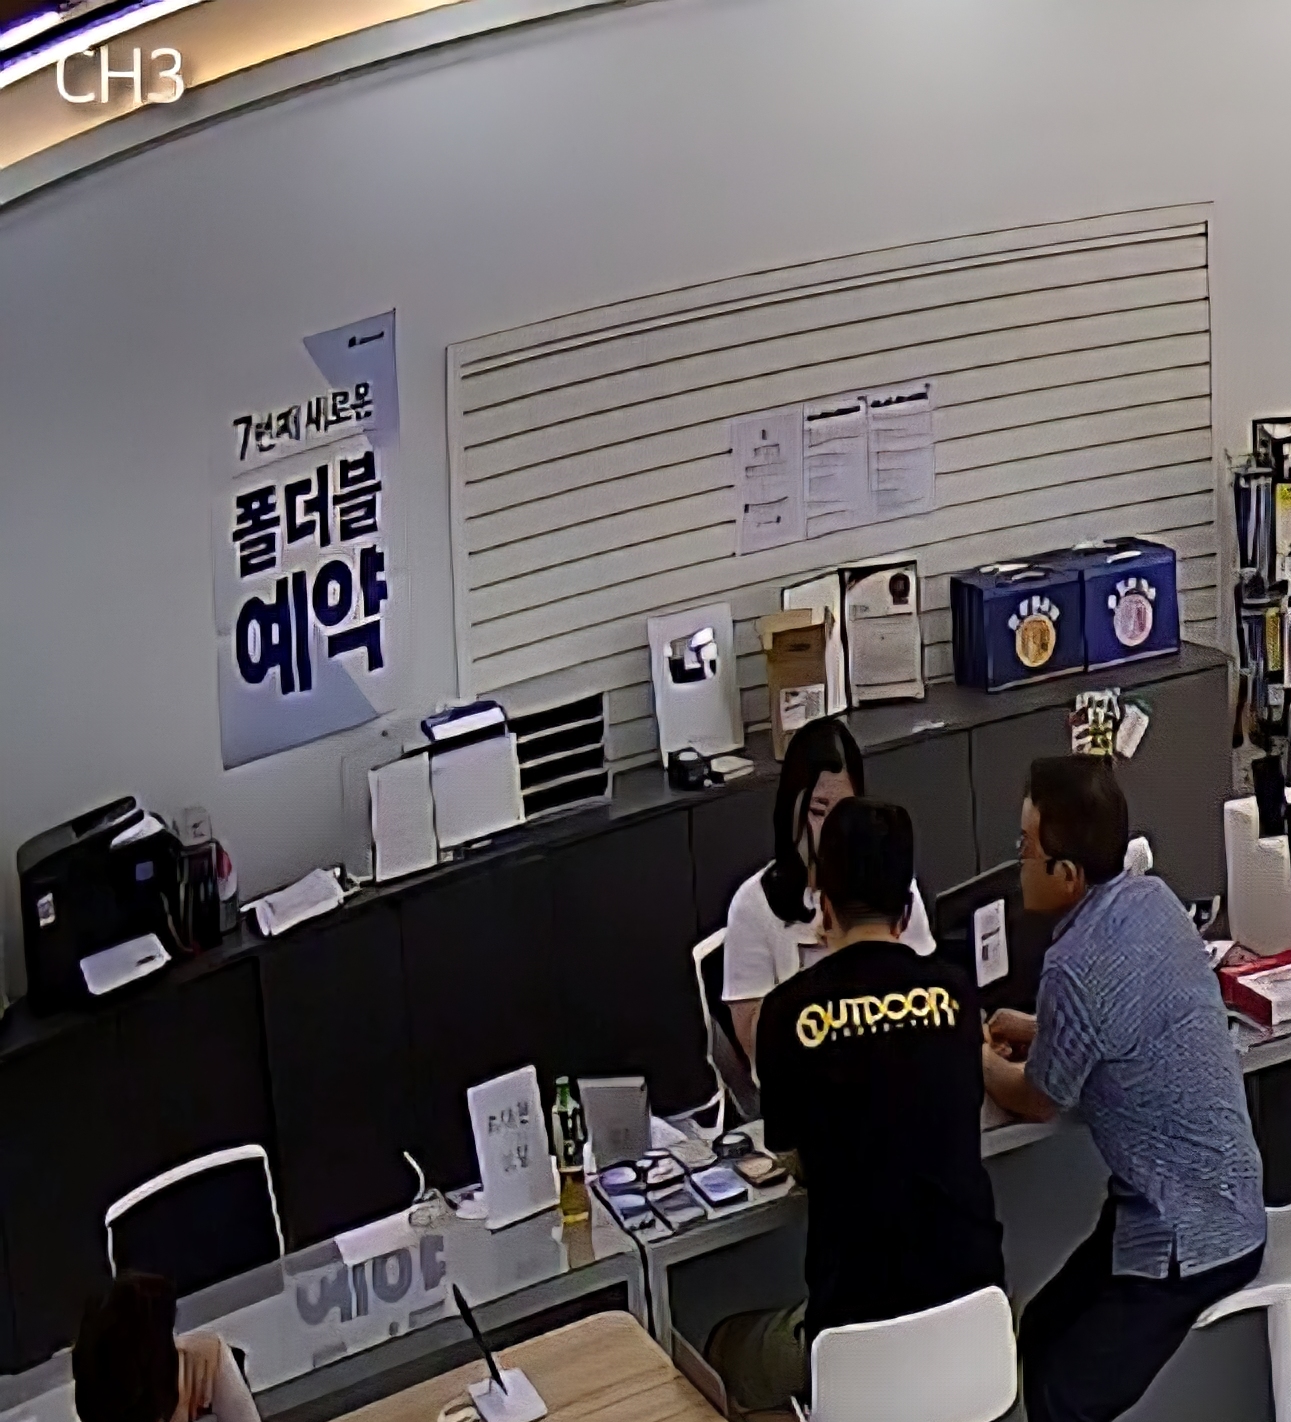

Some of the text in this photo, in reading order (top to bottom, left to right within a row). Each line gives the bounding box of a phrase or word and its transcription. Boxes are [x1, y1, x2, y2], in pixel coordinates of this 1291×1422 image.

[232, 450, 382, 578] 폴더블
[236, 544, 388, 696] 예약
[796, 986, 956, 1048] OUTDOOR
